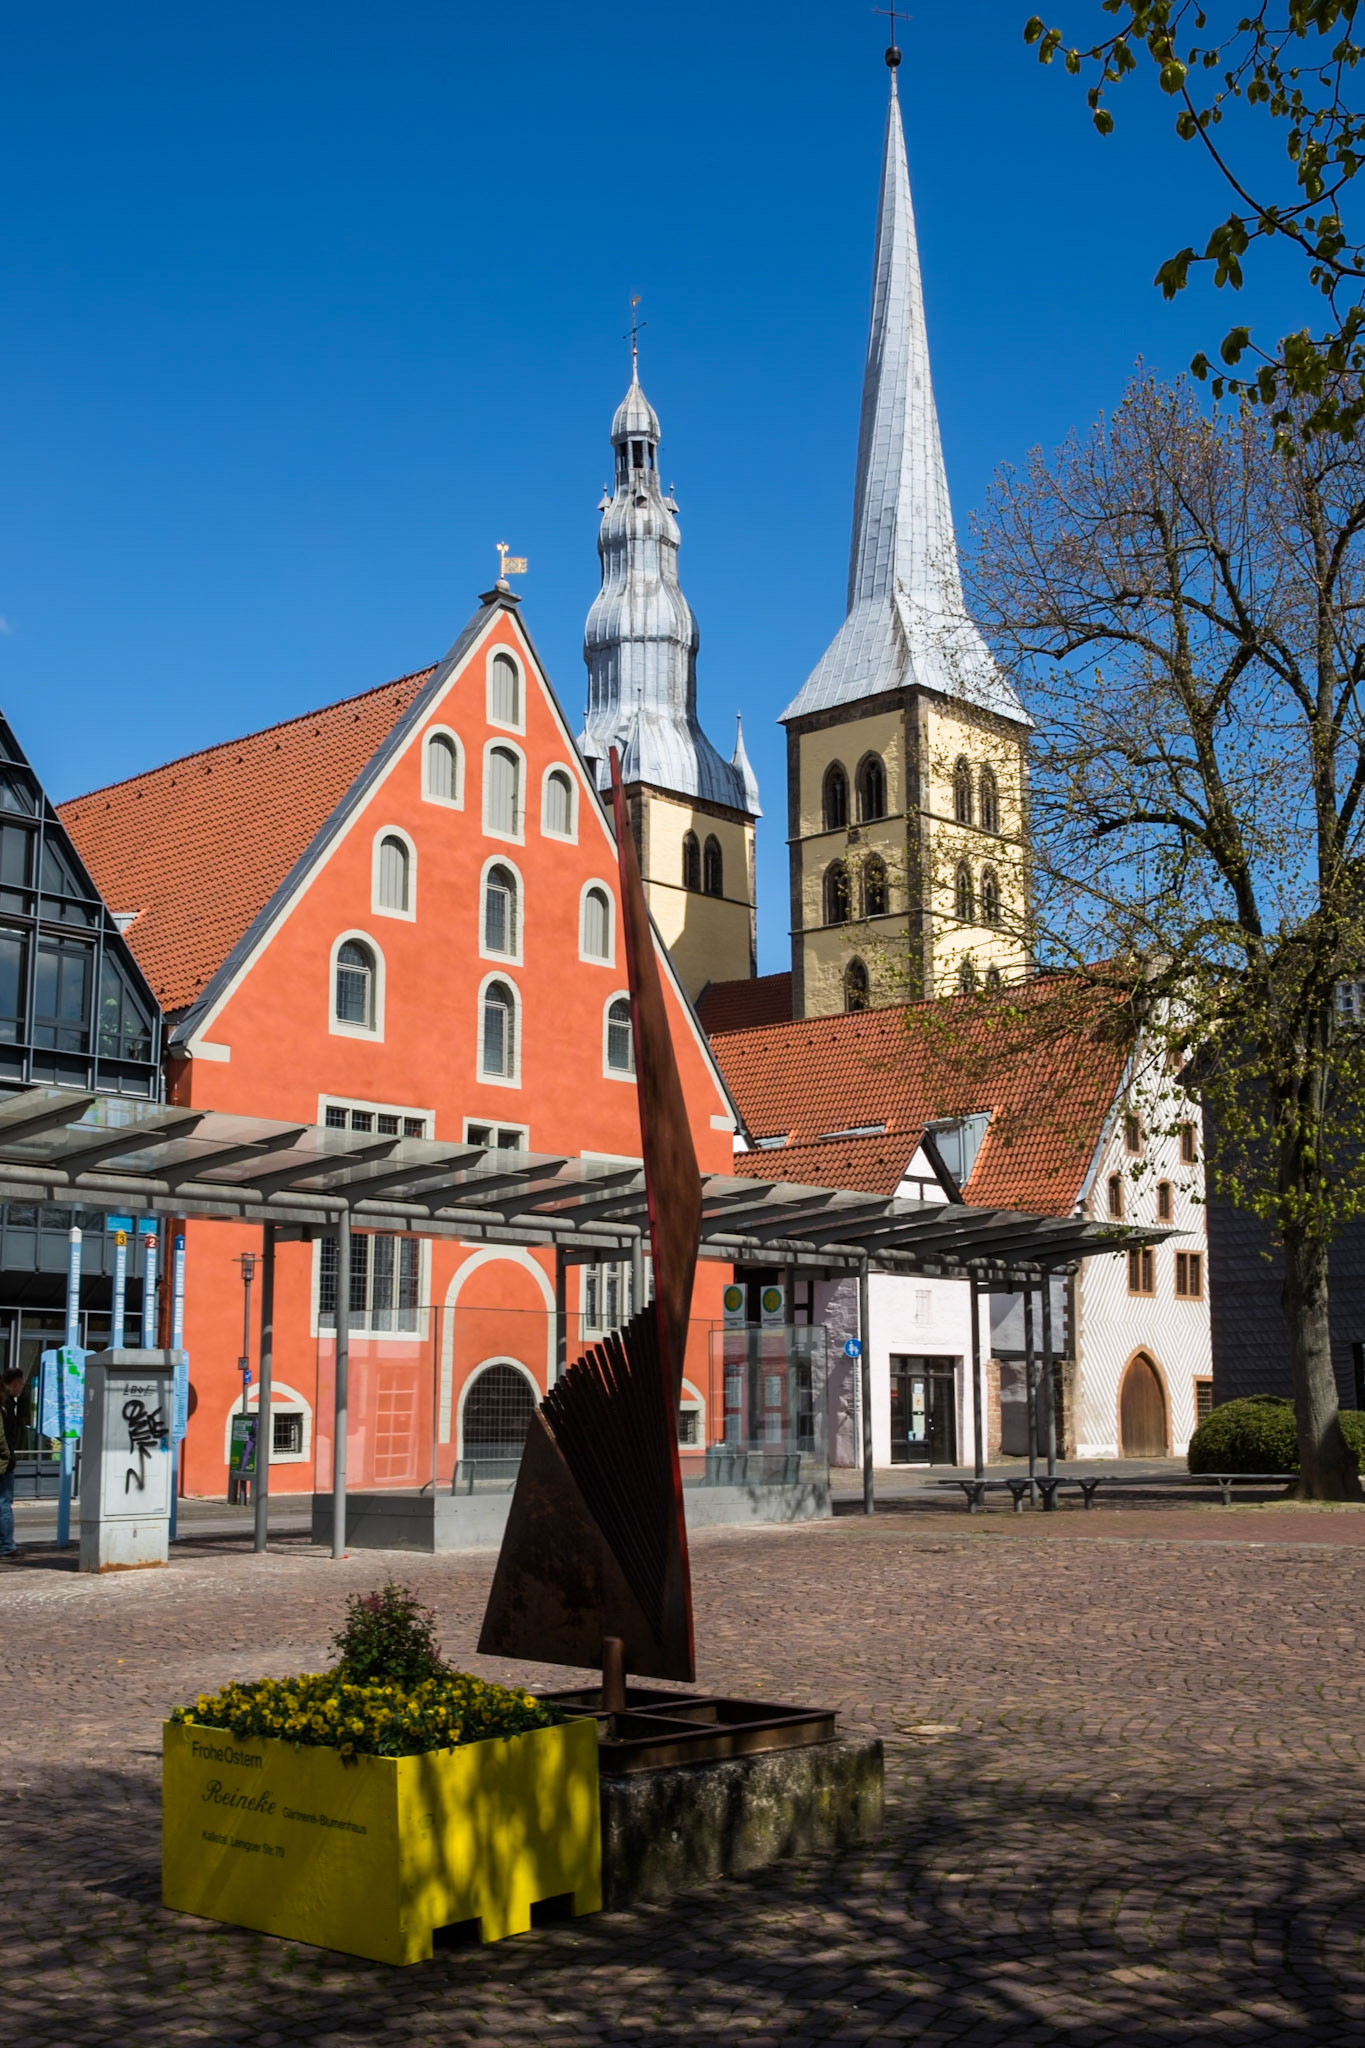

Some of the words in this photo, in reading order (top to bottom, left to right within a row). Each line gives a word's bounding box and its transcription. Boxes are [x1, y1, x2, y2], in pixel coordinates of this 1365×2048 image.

[119, 1235, 125, 1245] 3
[148, 1238, 156, 1247] 2
[179, 1240, 184, 1248] 1
[192, 1741, 223, 1762] Frohe
[224, 1746, 263, 1769] Ostern
[201, 1779, 277, 1815] Reineke
